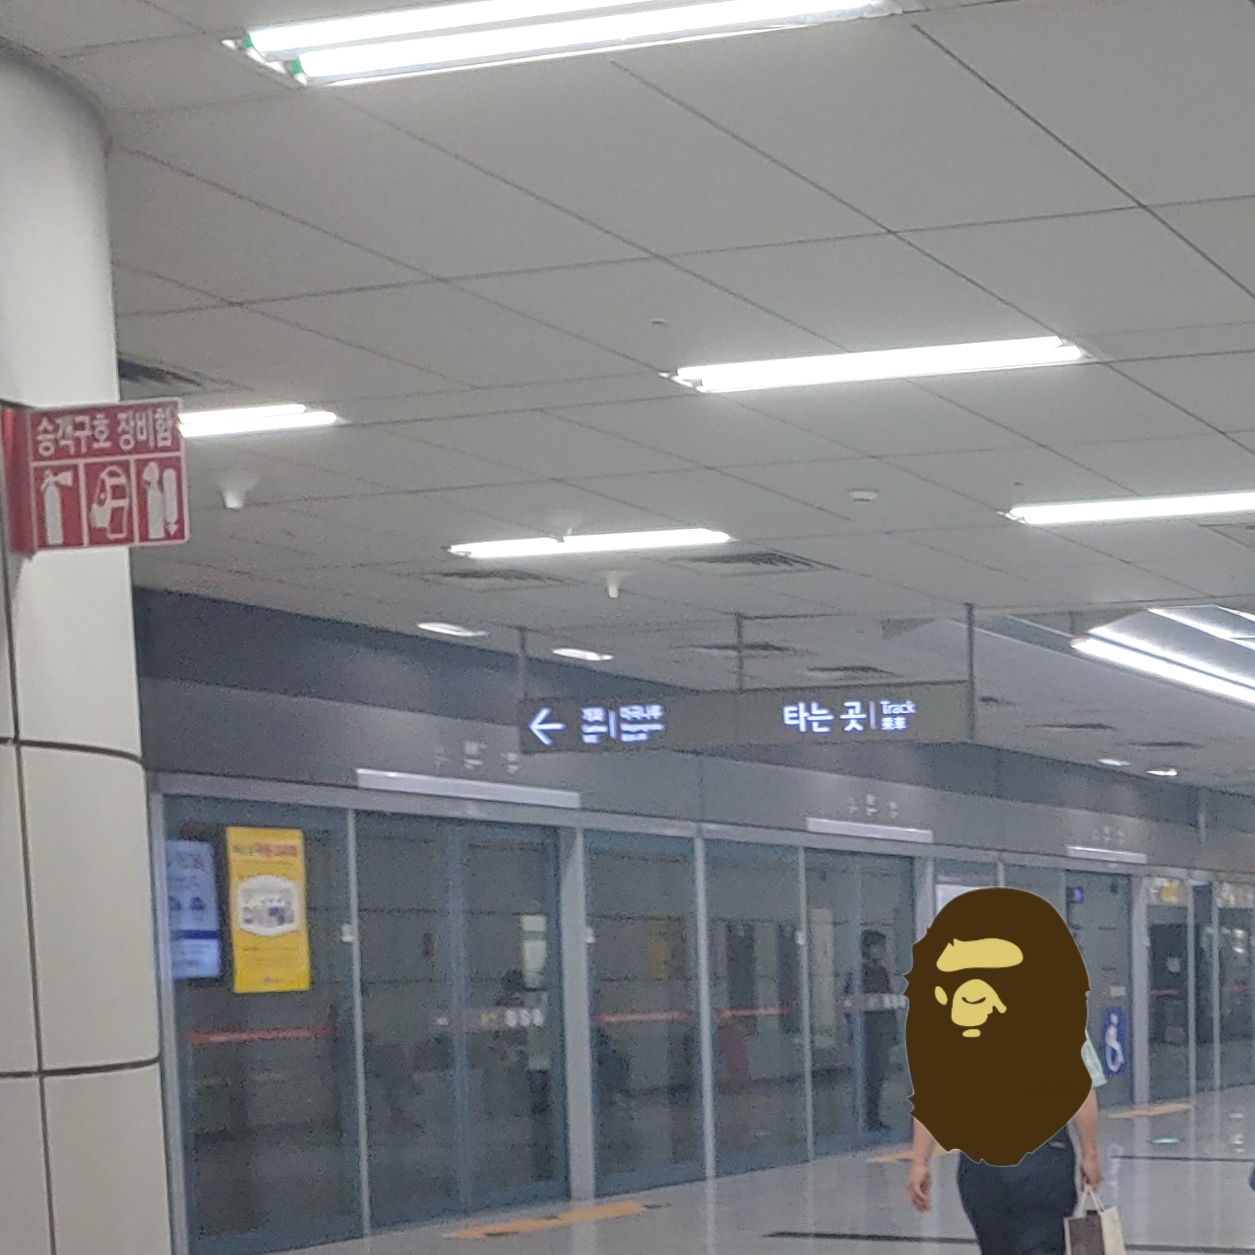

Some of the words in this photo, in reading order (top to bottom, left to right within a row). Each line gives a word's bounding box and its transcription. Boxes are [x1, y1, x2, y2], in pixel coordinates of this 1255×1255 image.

[36, 413, 113, 457] 승객구호
[116, 407, 172, 452] 장비함
[782, 700, 835, 733] 타는
[839, 700, 867, 732] 곳
